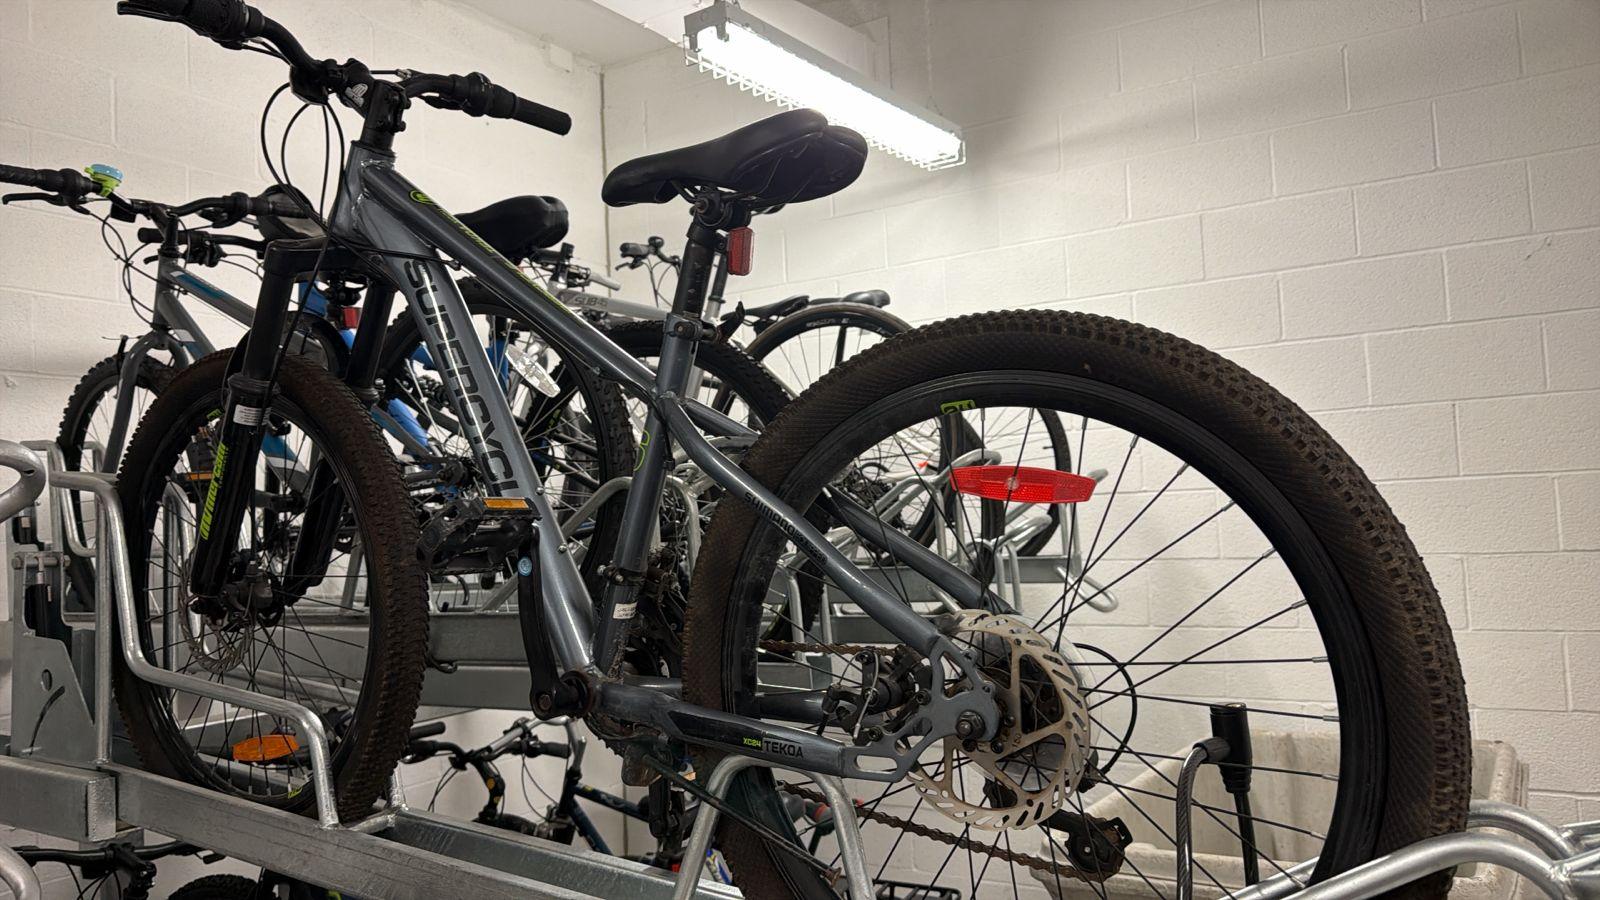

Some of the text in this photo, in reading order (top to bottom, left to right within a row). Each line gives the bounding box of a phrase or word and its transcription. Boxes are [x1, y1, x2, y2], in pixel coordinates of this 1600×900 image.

[404, 260, 519, 498] SUPERCYCL
[744, 492, 796, 538] SHIMANO
[743, 737, 804, 758] XC24 TEKOA
